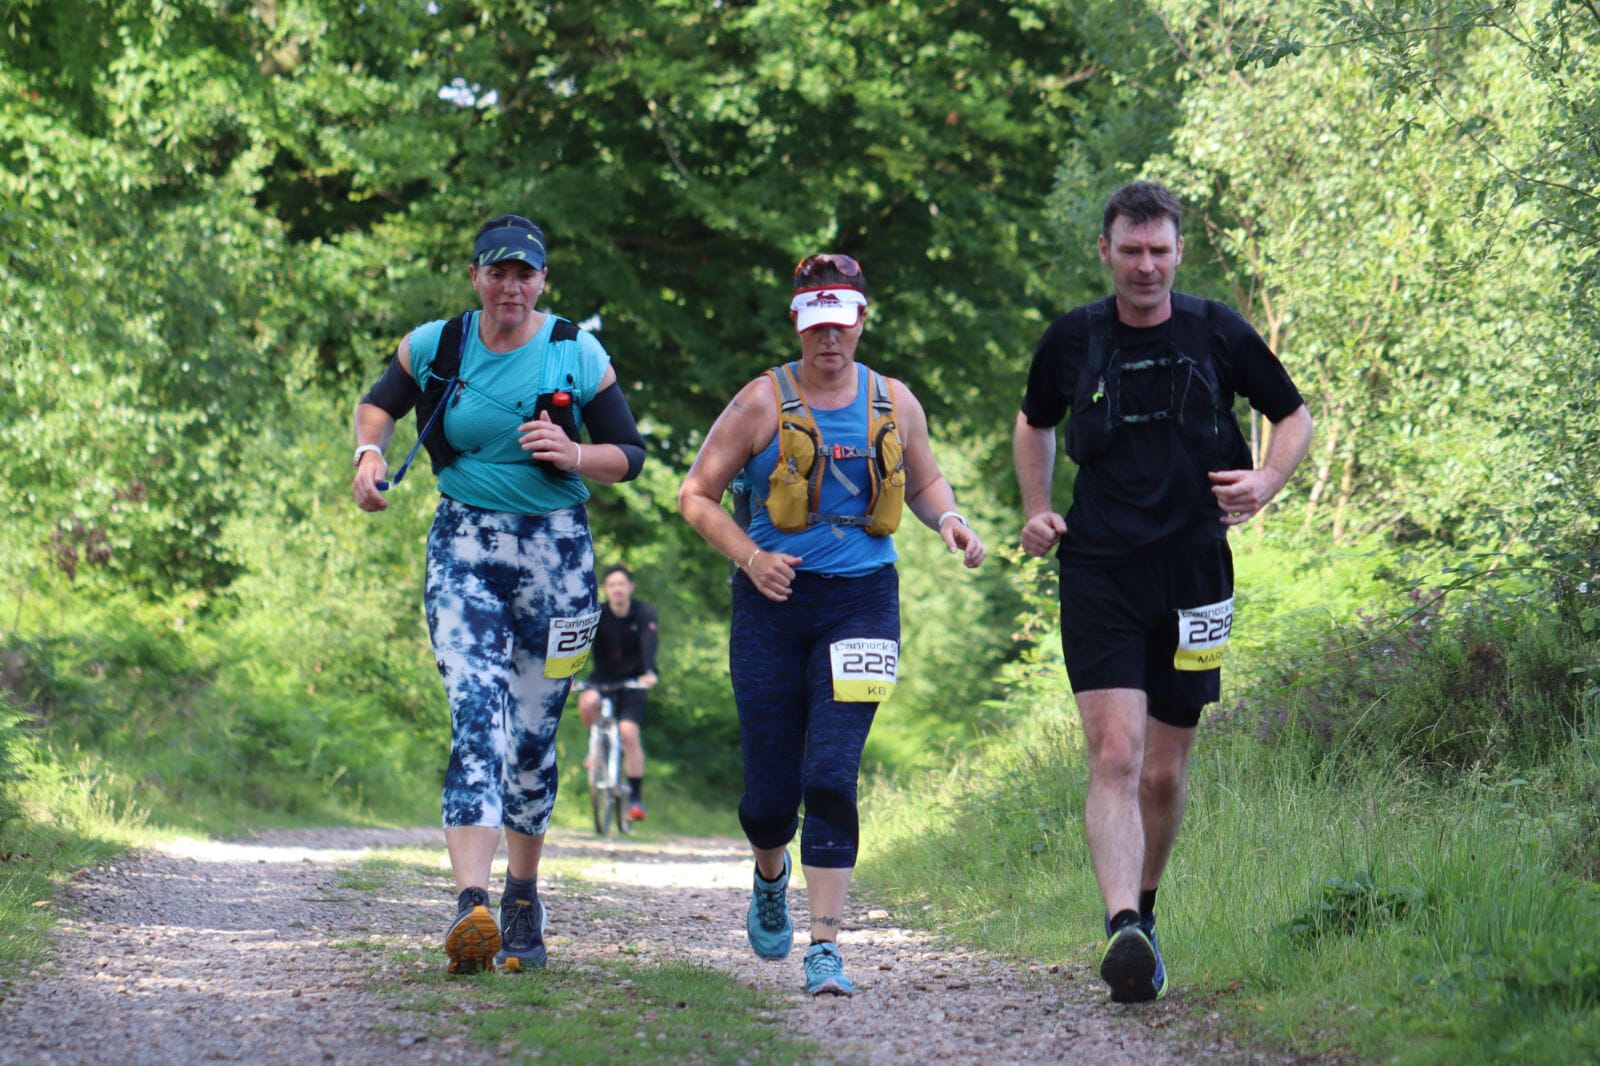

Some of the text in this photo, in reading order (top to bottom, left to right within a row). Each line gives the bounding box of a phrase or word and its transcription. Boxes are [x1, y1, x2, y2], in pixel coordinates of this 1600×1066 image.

[558, 624, 599, 651] 230
[1190, 613, 1232, 643] 229
[835, 642, 888, 651] Cannock
[843, 653, 896, 676] 228
[868, 686, 886, 695] KB
